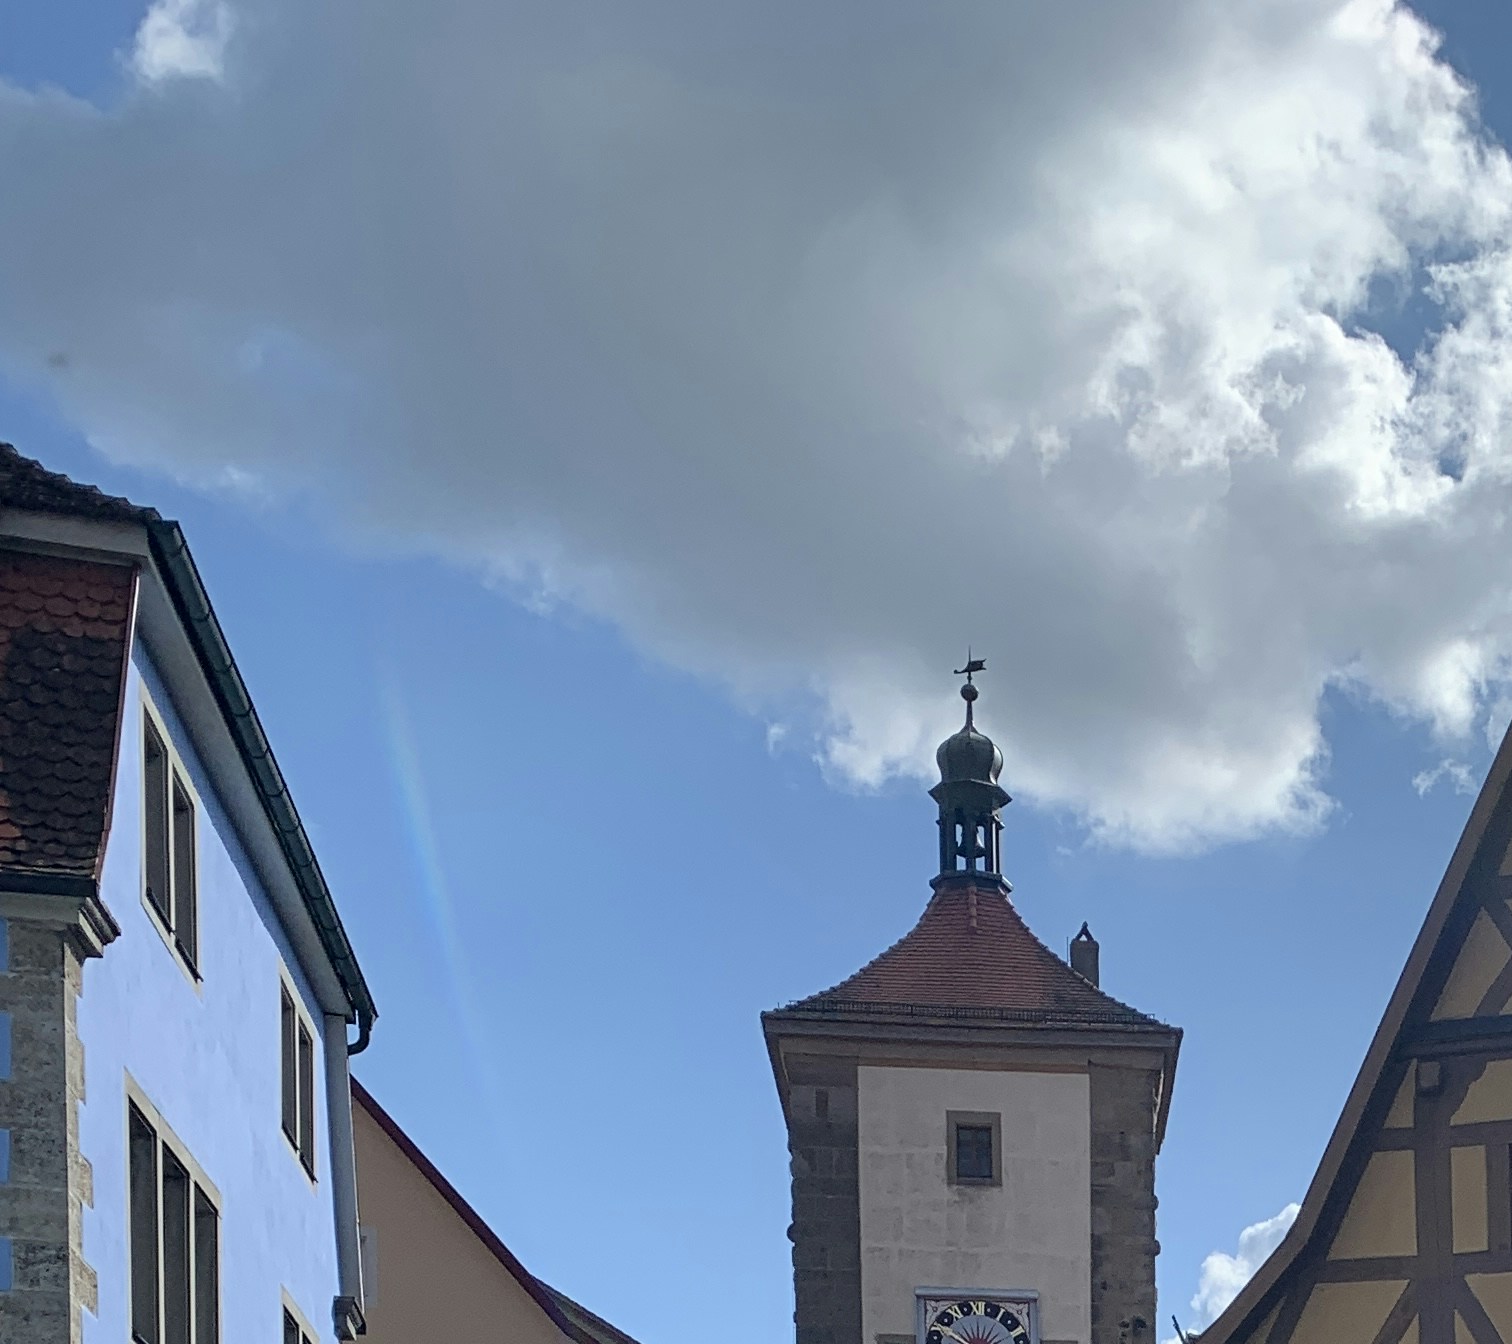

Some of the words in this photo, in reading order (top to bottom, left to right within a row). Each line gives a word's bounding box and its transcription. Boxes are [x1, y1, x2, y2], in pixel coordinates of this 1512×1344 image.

[946, 1305, 963, 1321] XI
[969, 1301, 985, 1316] XII
[996, 1308, 1005, 1321] I
[1010, 1325, 1025, 1338] II
